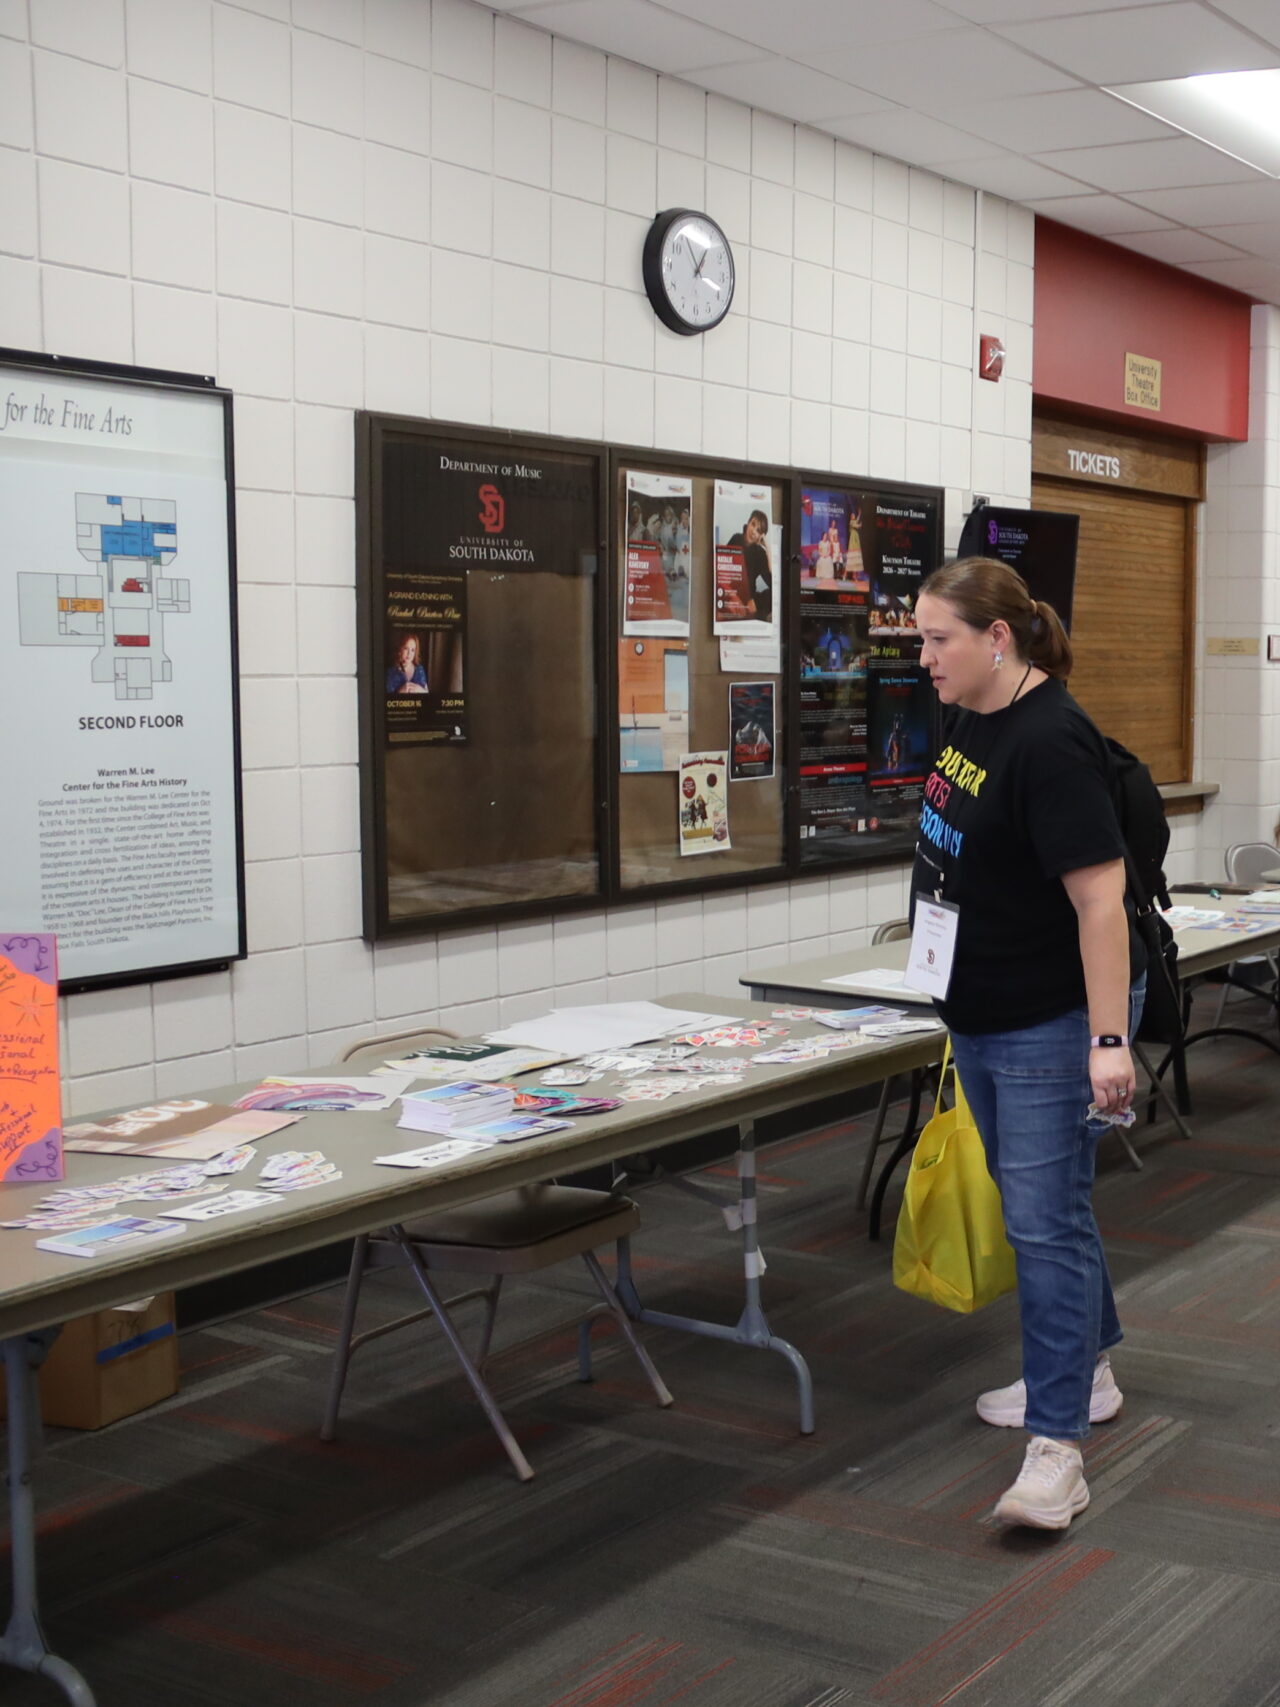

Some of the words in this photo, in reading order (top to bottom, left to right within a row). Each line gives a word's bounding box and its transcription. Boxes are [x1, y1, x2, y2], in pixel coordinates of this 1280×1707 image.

[1128, 359, 1158, 381] University
[1132, 373, 1155, 391] Theatre
[1127, 387, 1138, 401] Box
[1140, 390, 1159, 407] Office
[0, 392, 28, 430] for
[33, 393, 56, 426] the
[60, 399, 96, 430] Fine
[99, 406, 133, 436] Arts
[440, 456, 499, 475] DEPARTMENT
[515, 464, 543, 479] MUSIC
[1067, 449, 1120, 479] TICKETS
[460, 536, 509, 546] UNIVERSITY
[513, 539, 524, 547] OF
[449, 545, 487, 559] SOUTH
[490, 547, 535, 562] DAKOTA
[78, 716, 136, 730] SECOND
[139, 714, 184, 728] FLOOR
[97, 768, 127, 777] Warren
[129, 767, 139, 776] M.
[141, 767, 155, 775] Lee
[62, 783, 90, 792] Center
[93, 781, 106, 791] for
[106, 780, 120, 789] the
[122, 779, 139, 789] Fine
[141, 778, 157, 787] Arts
[159, 777, 187, 788] History
